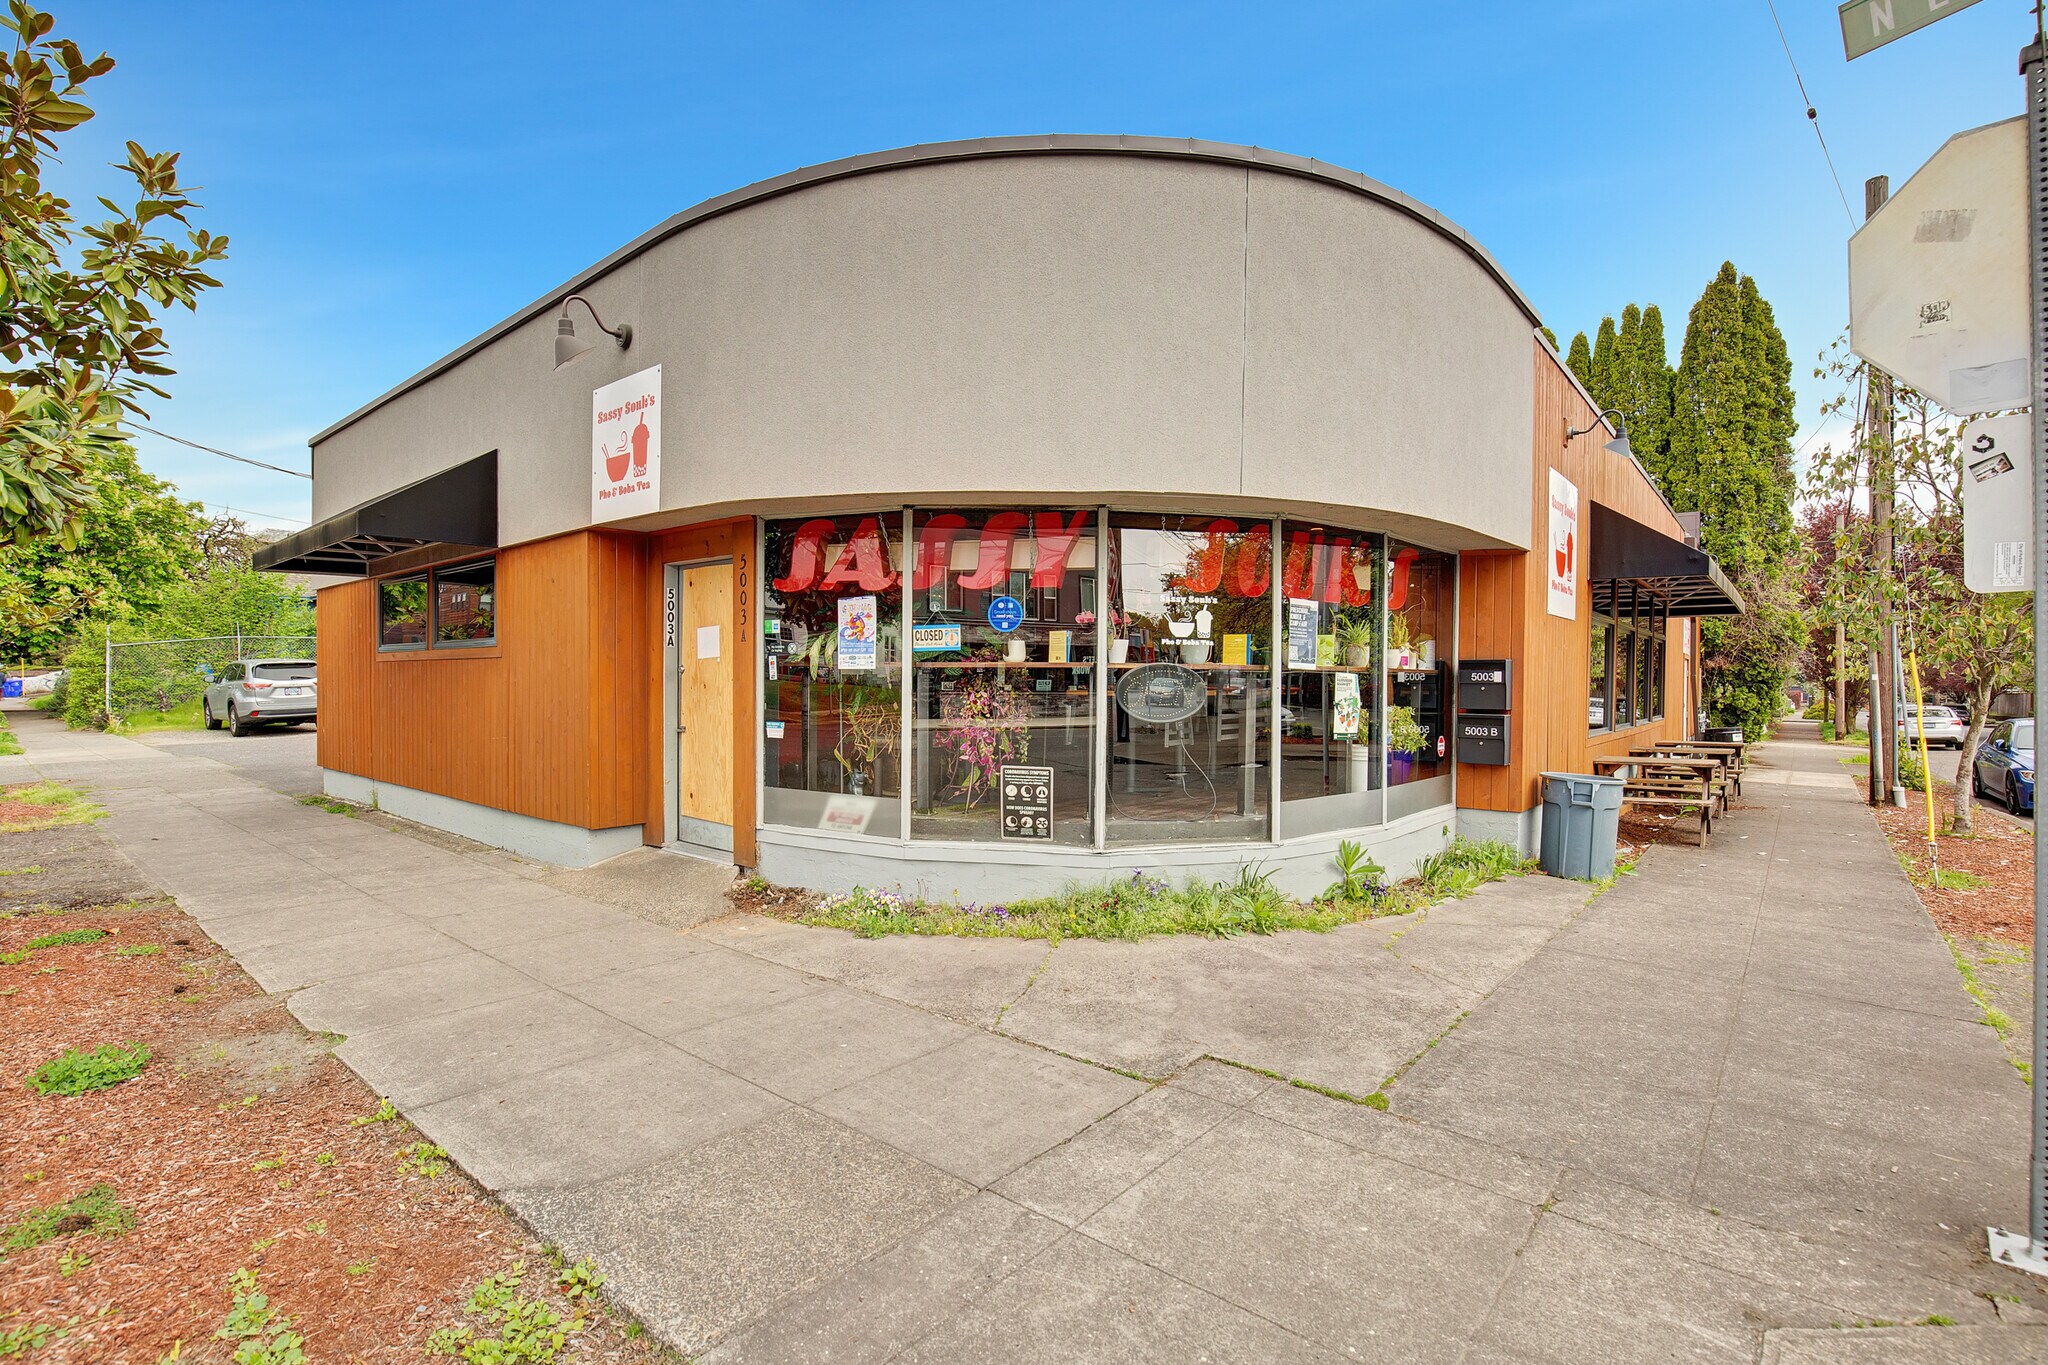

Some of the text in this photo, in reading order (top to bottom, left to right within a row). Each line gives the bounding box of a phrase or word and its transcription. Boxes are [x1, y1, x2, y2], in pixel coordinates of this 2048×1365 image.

[1869, 0, 1896, 37] N
[597, 406, 624, 425] Sassy
[599, 480, 651, 500] Pho & Boba Tea
[1159, 594, 1187, 605] Sassy
[667, 588, 675, 647] 5003A
[914, 629, 944, 642] CLOSED
[1471, 672, 1494, 682] 5003
[1464, 726, 1498, 737] 5003 B
